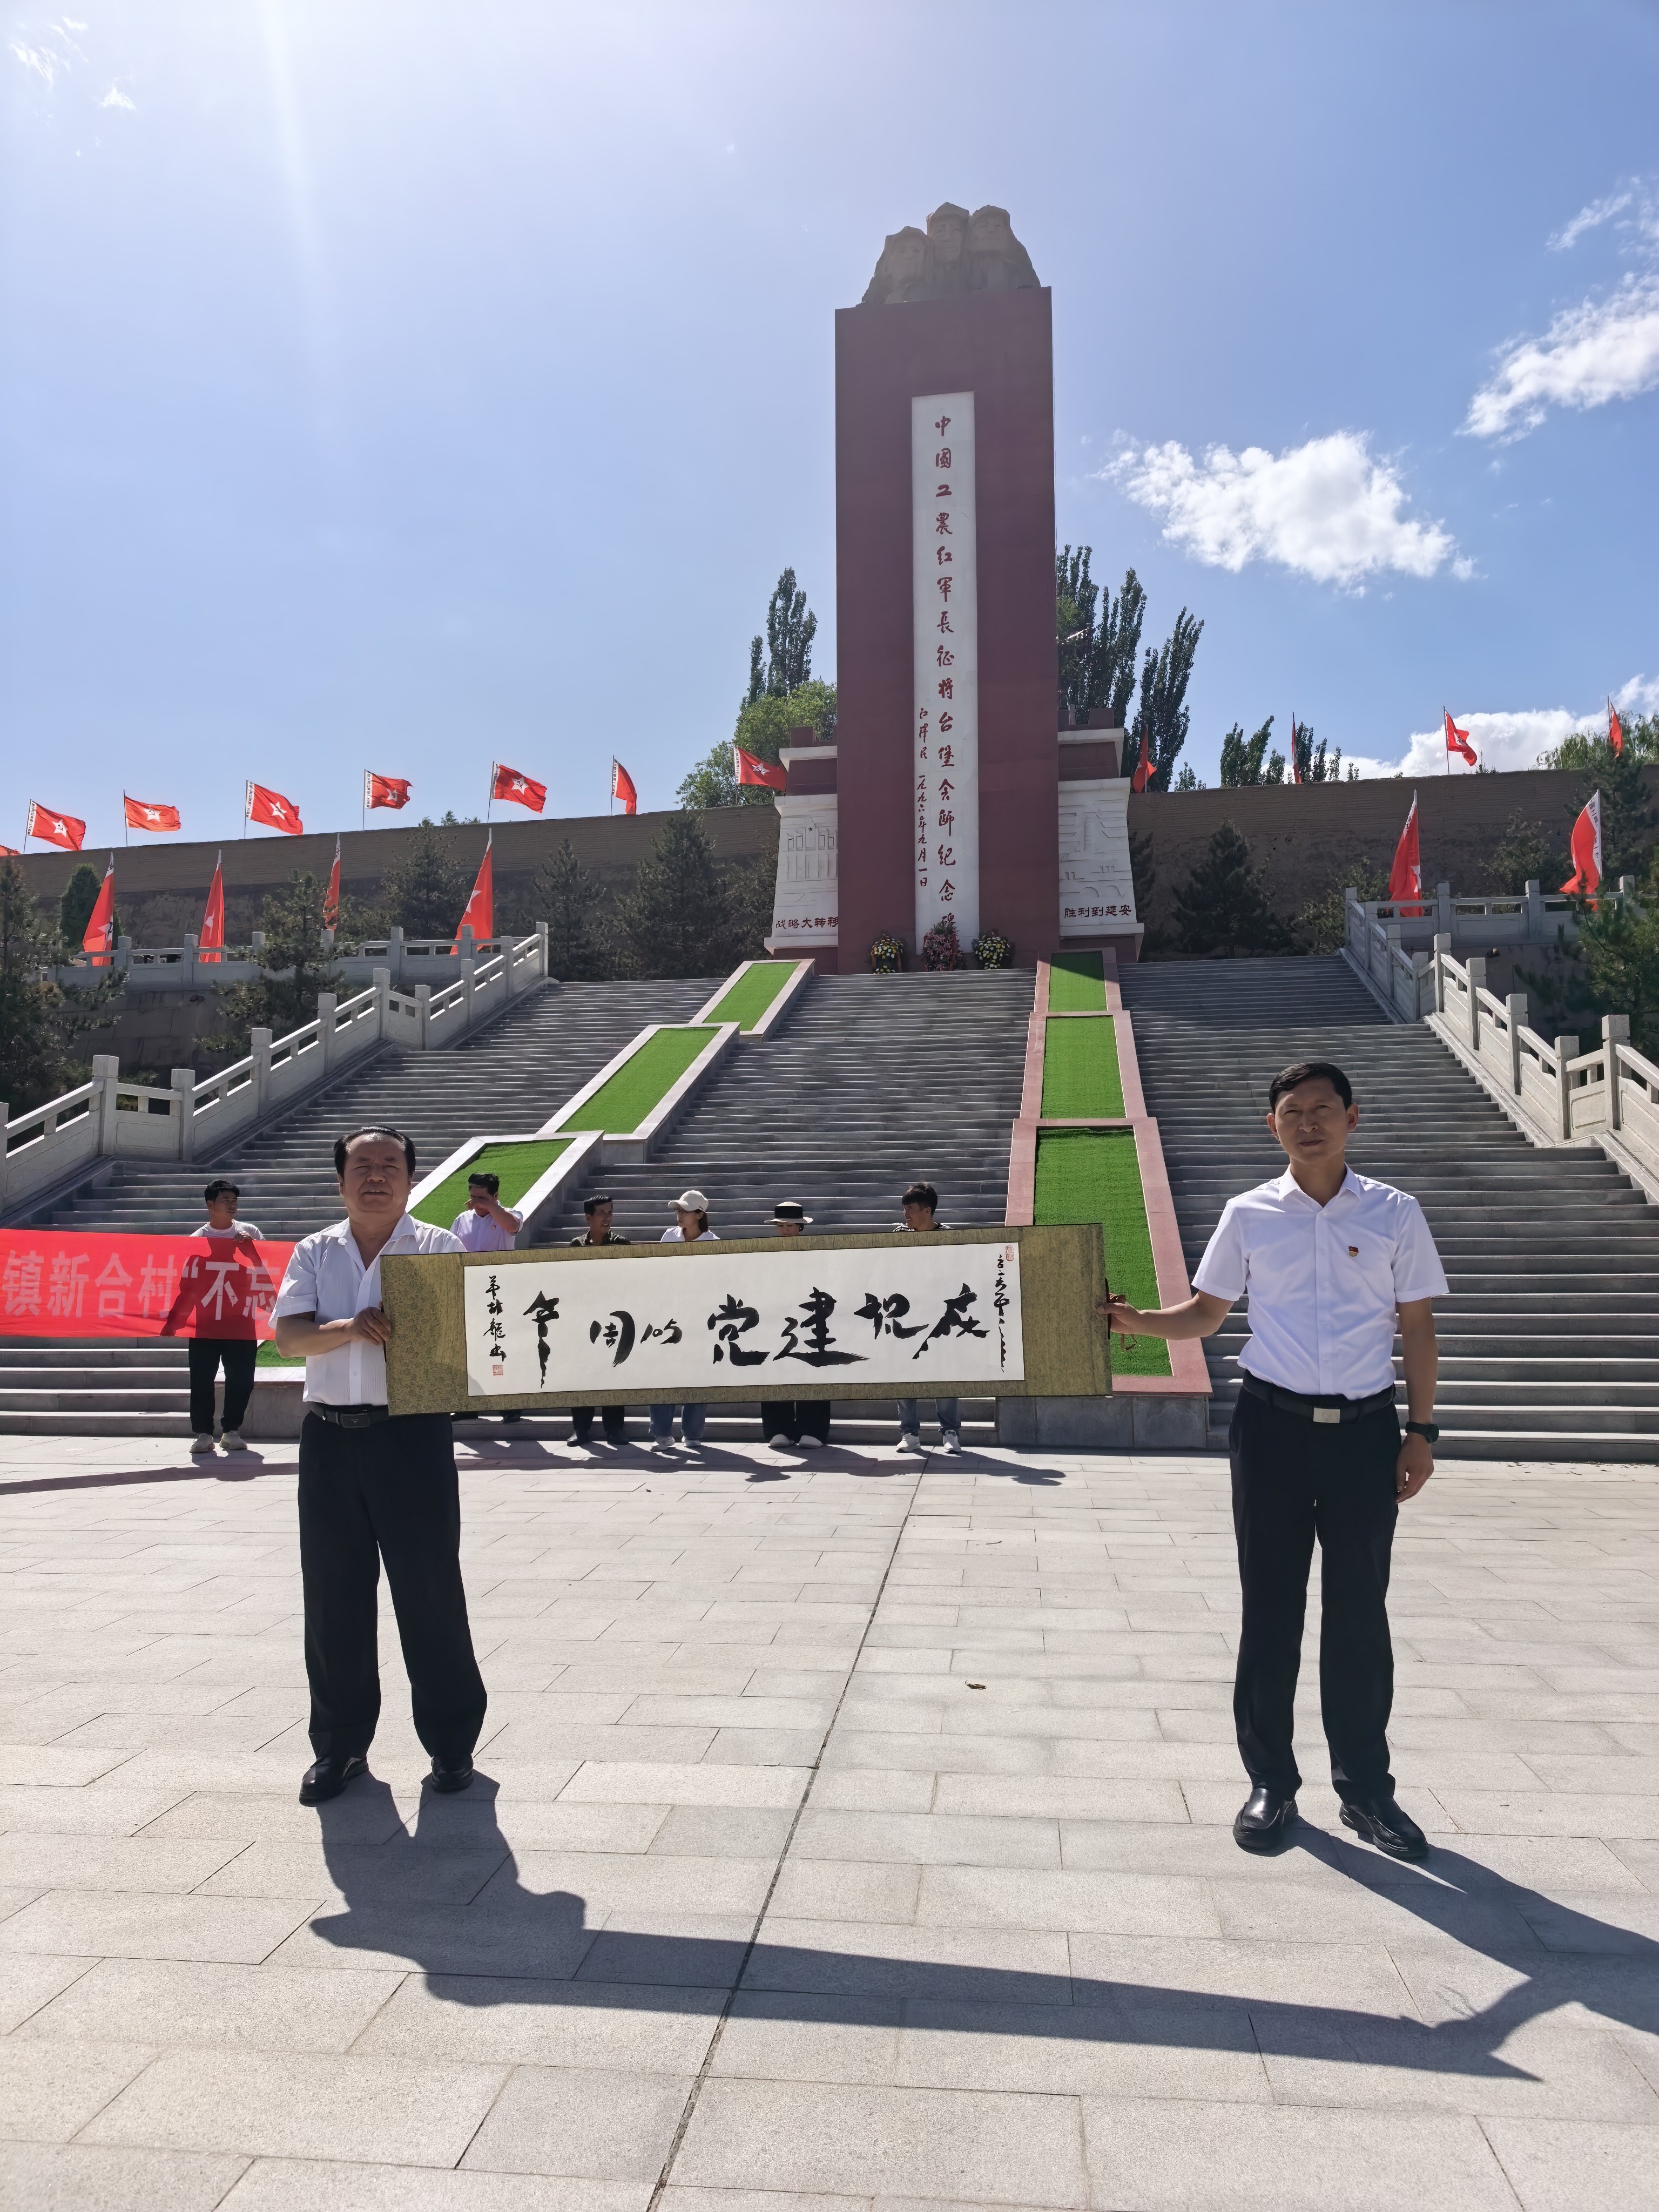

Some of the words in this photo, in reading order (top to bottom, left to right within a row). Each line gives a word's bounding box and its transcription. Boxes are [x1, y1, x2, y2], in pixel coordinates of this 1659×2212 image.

[1064, 904, 1132, 919] 胜利到延安
[775, 916, 839, 929] 战略大转移
